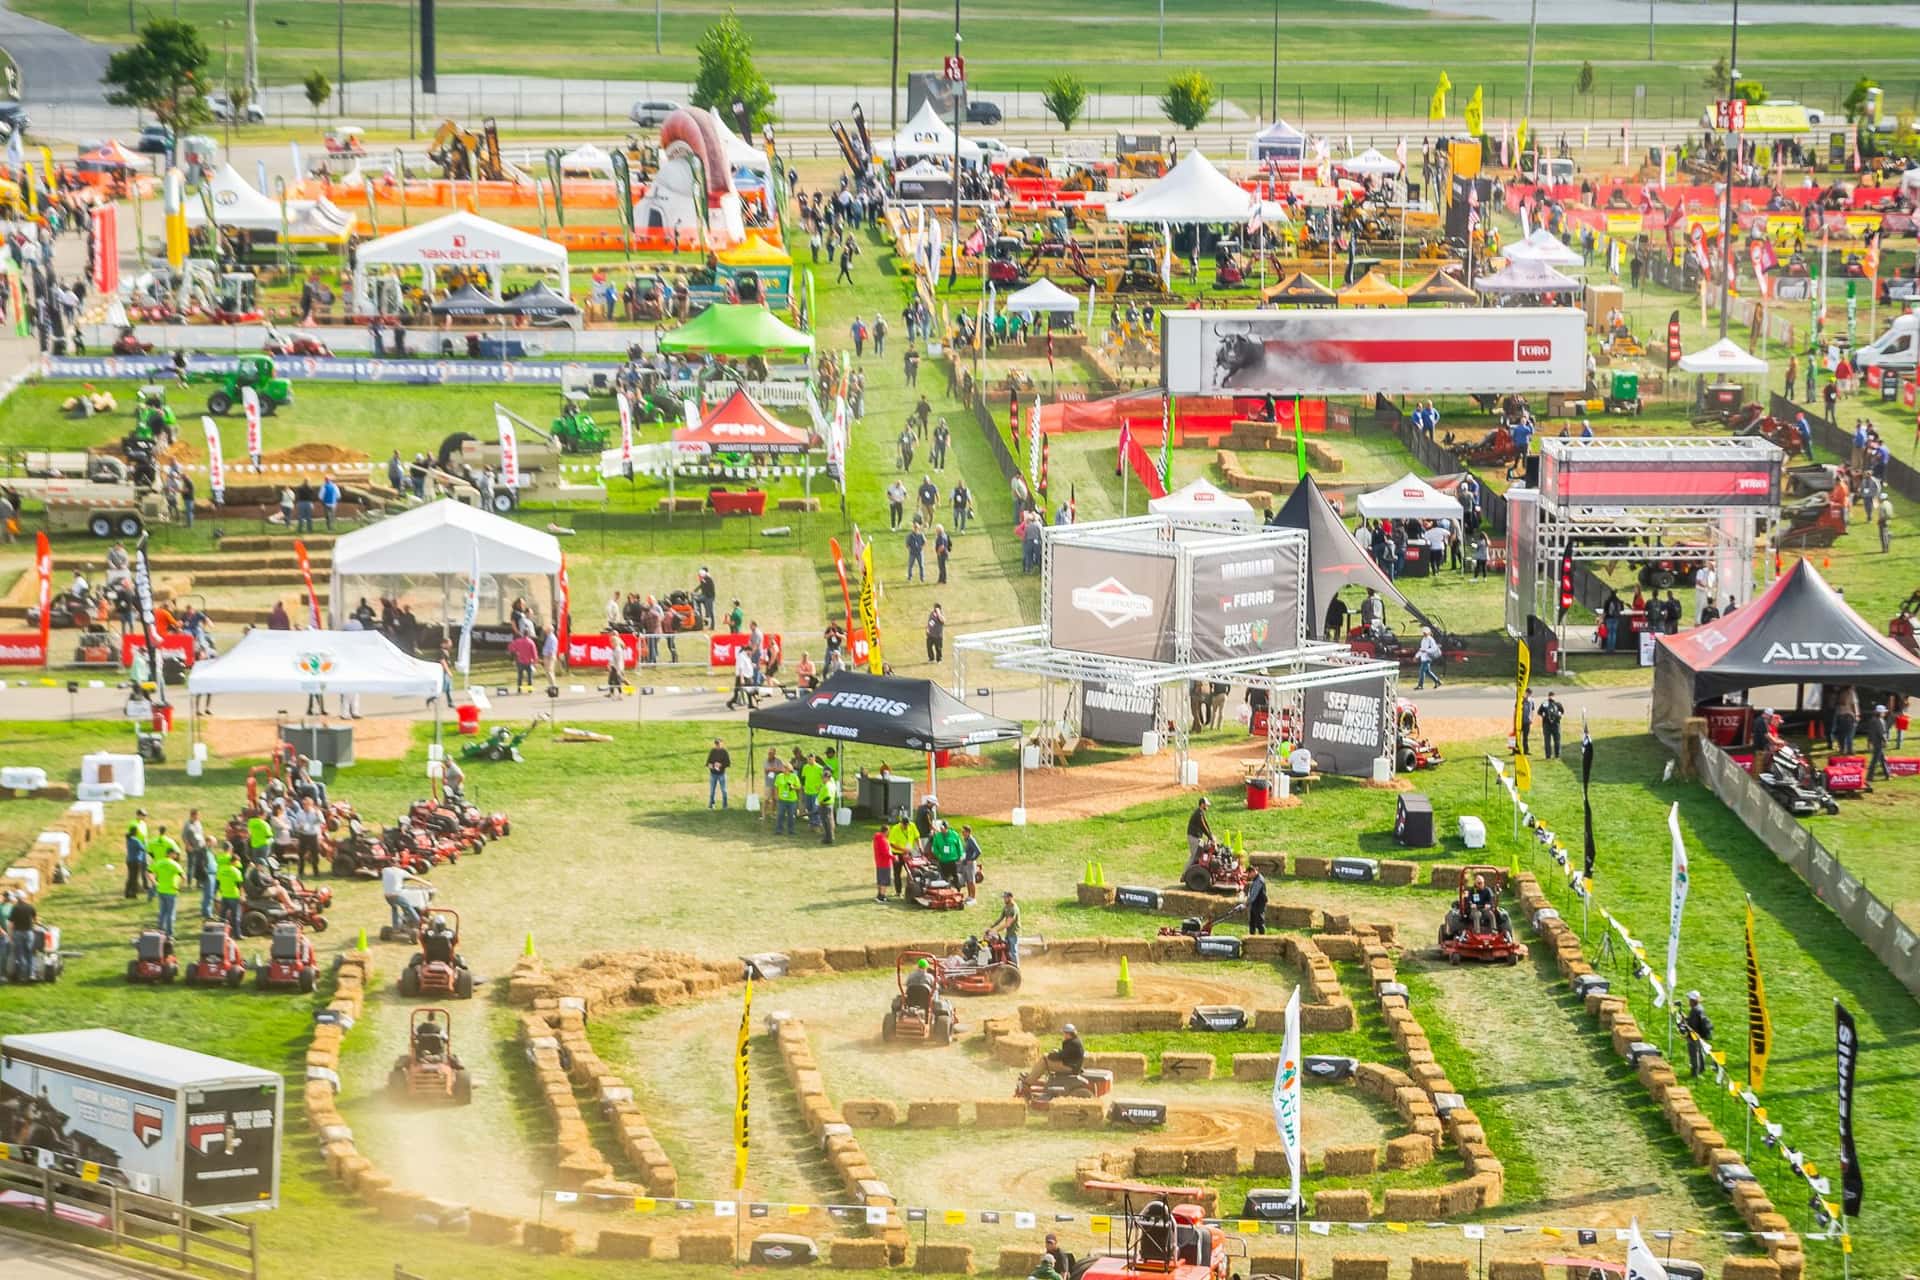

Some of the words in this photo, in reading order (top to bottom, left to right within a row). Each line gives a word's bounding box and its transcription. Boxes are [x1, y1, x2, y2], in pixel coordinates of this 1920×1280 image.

[914, 132, 940, 143] CAT
[1519, 345, 1550, 356] TORO
[711, 423, 766, 436] FINN
[1234, 590, 1276, 608] FERRIS
[1224, 622, 1254, 637] BILLY
[1223, 632, 1253, 648] GOAT
[1762, 642, 1869, 663] ALTOZ
[829, 692, 908, 717] FERRIS
[1327, 691, 1349, 710] SEE
[1347, 694, 1380, 714] MORE
[1342, 710, 1379, 730] INSIDE
[827, 725, 859, 738] FERRIS
[1830, 773, 1861, 784] ALTOZ
[1125, 892, 1150, 904] FERRIS
[1128, 1108, 1158, 1119] FERRIS
[1261, 1201, 1294, 1211] FERRIS
